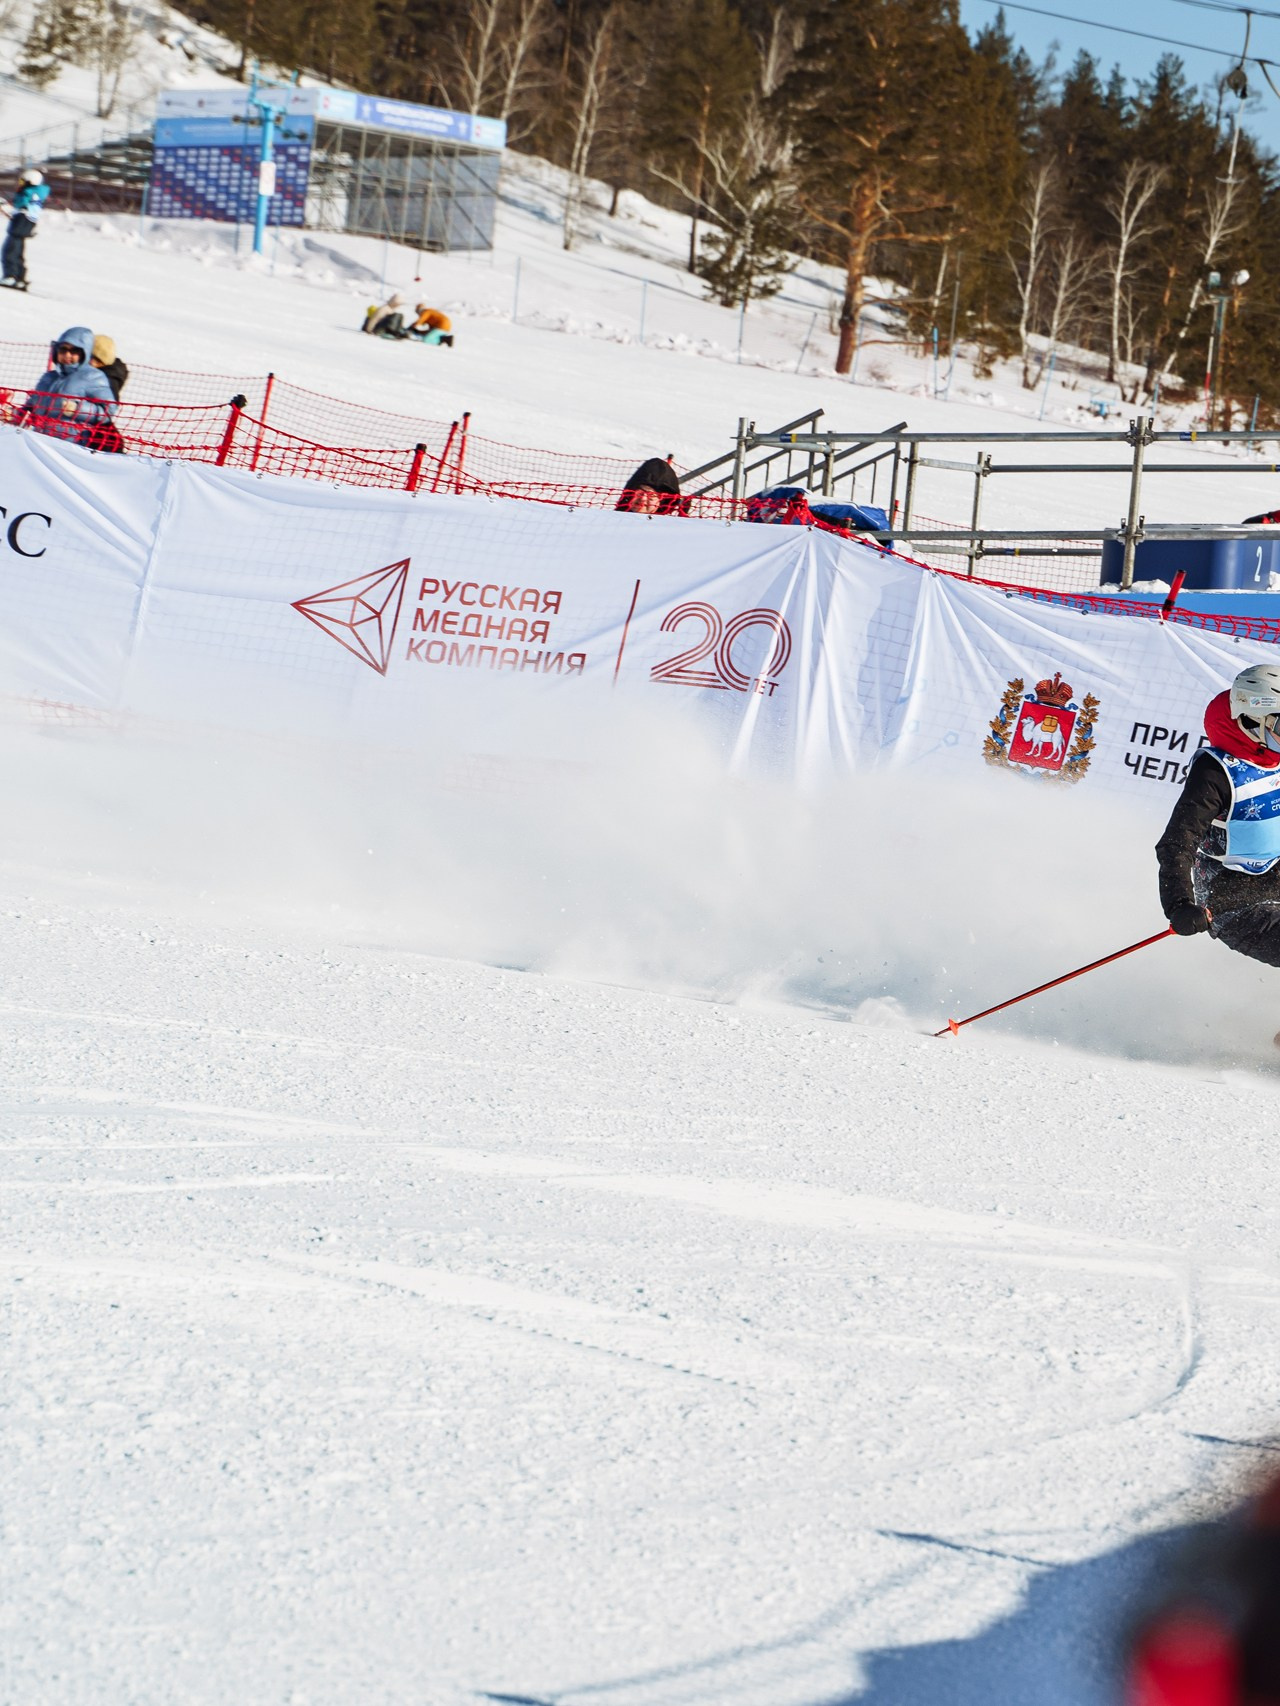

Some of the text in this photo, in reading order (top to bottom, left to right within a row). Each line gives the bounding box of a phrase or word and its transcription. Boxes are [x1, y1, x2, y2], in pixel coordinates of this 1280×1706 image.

[1254, 545, 1263, 582] 2
[418, 577, 563, 615] РУССКАЯ
[412, 607, 551, 644] МЕДНАЯ
[405, 637, 587, 676] КОМПАНИЯ
[650, 601, 792, 692] 20
[1129, 722, 1189, 753] ПРИ
